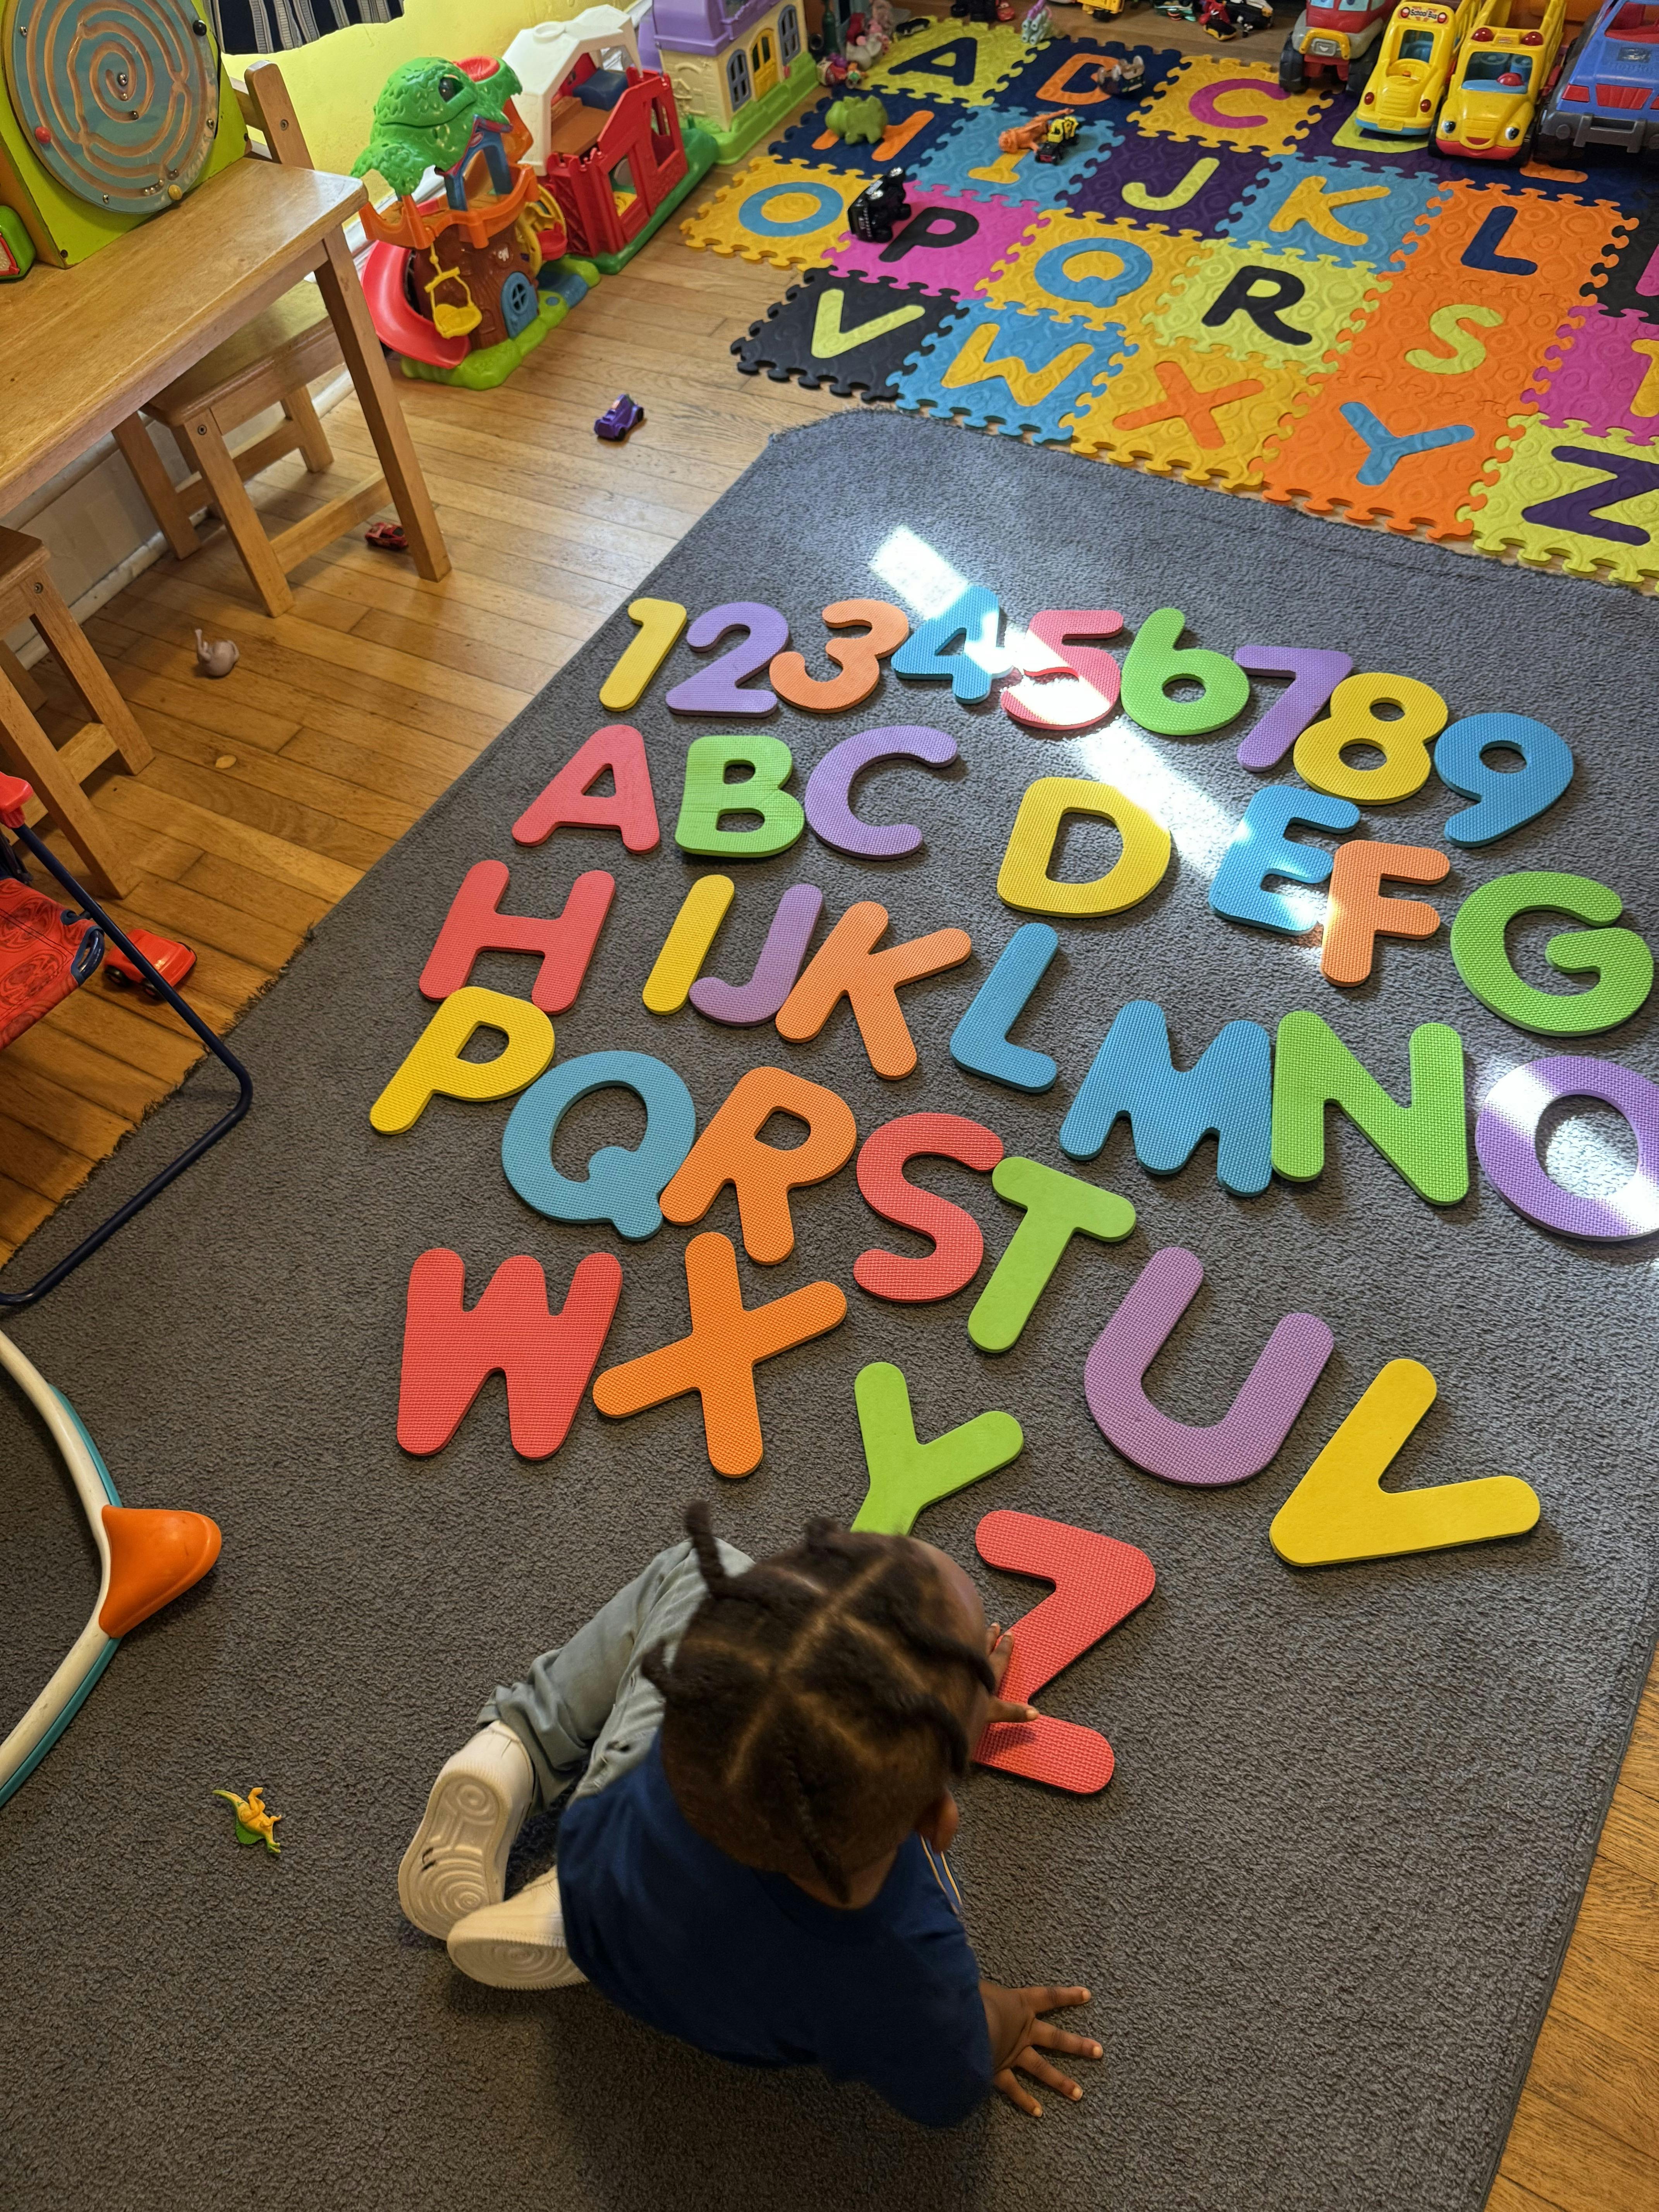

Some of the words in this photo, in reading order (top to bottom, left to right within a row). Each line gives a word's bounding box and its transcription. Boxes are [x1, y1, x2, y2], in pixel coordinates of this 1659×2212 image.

[888, 37, 977, 86] A
[1189, 79, 1290, 128] C
[738, 181, 843, 237] O
[879, 207, 979, 263] P
[1034, 237, 1152, 307] Q
[1202, 266, 1312, 345] R
[1405, 304, 1504, 374] S
[1121, 157, 1220, 211] J
[1269, 176, 1391, 246] K
[1461, 206, 1537, 275] L
[811, 289, 925, 358] V
[941, 324, 1093, 407] W
[1113, 361, 1264, 449] X
[1339, 402, 1475, 485] Y
[1521, 445, 1659, 546] Z
[599, 598, 687, 711] 1
[666, 602, 789, 717] 2
[770, 599, 909, 713] 3
[891, 586, 1014, 704] 4
[1001, 610, 1123, 730] 5
[1121, 608, 1249, 735] 6
[1234, 645, 1353, 772] 7
[1293, 672, 1449, 805] 8
[1434, 712, 1573, 848] 9
[512, 725, 660, 853] A
[675, 736, 805, 857] B
[805, 725, 958, 860] C
[997, 777, 1171, 917] D
[1209, 785, 1360, 936] E
[1321, 840, 1450, 987] F
[1450, 871, 1654, 1037] G
[419, 860, 615, 1015] H
[642, 875, 735, 1015] I
[689, 884, 823, 1027] J
[775, 901, 972, 1080] K
[950, 923, 1058, 1093] L
[1060, 1000, 1273, 1197] M
[1271, 1010, 1469, 1205] N
[1475, 1056, 1659, 1242] O
[370, 986, 555, 1135] P
[501, 1050, 697, 1242] Q
[660, 1066, 857, 1265] R
[854, 1113, 1005, 1303] S
[968, 1156, 1137, 1353] T
[1084, 1247, 1334, 1487] U
[1269, 1359, 1540, 1567] V
[397, 1248, 623, 1460] W
[592, 1231, 847, 1478] X
[851, 1362, 1024, 1536] Y
[974, 1510, 1156, 1795] Z
